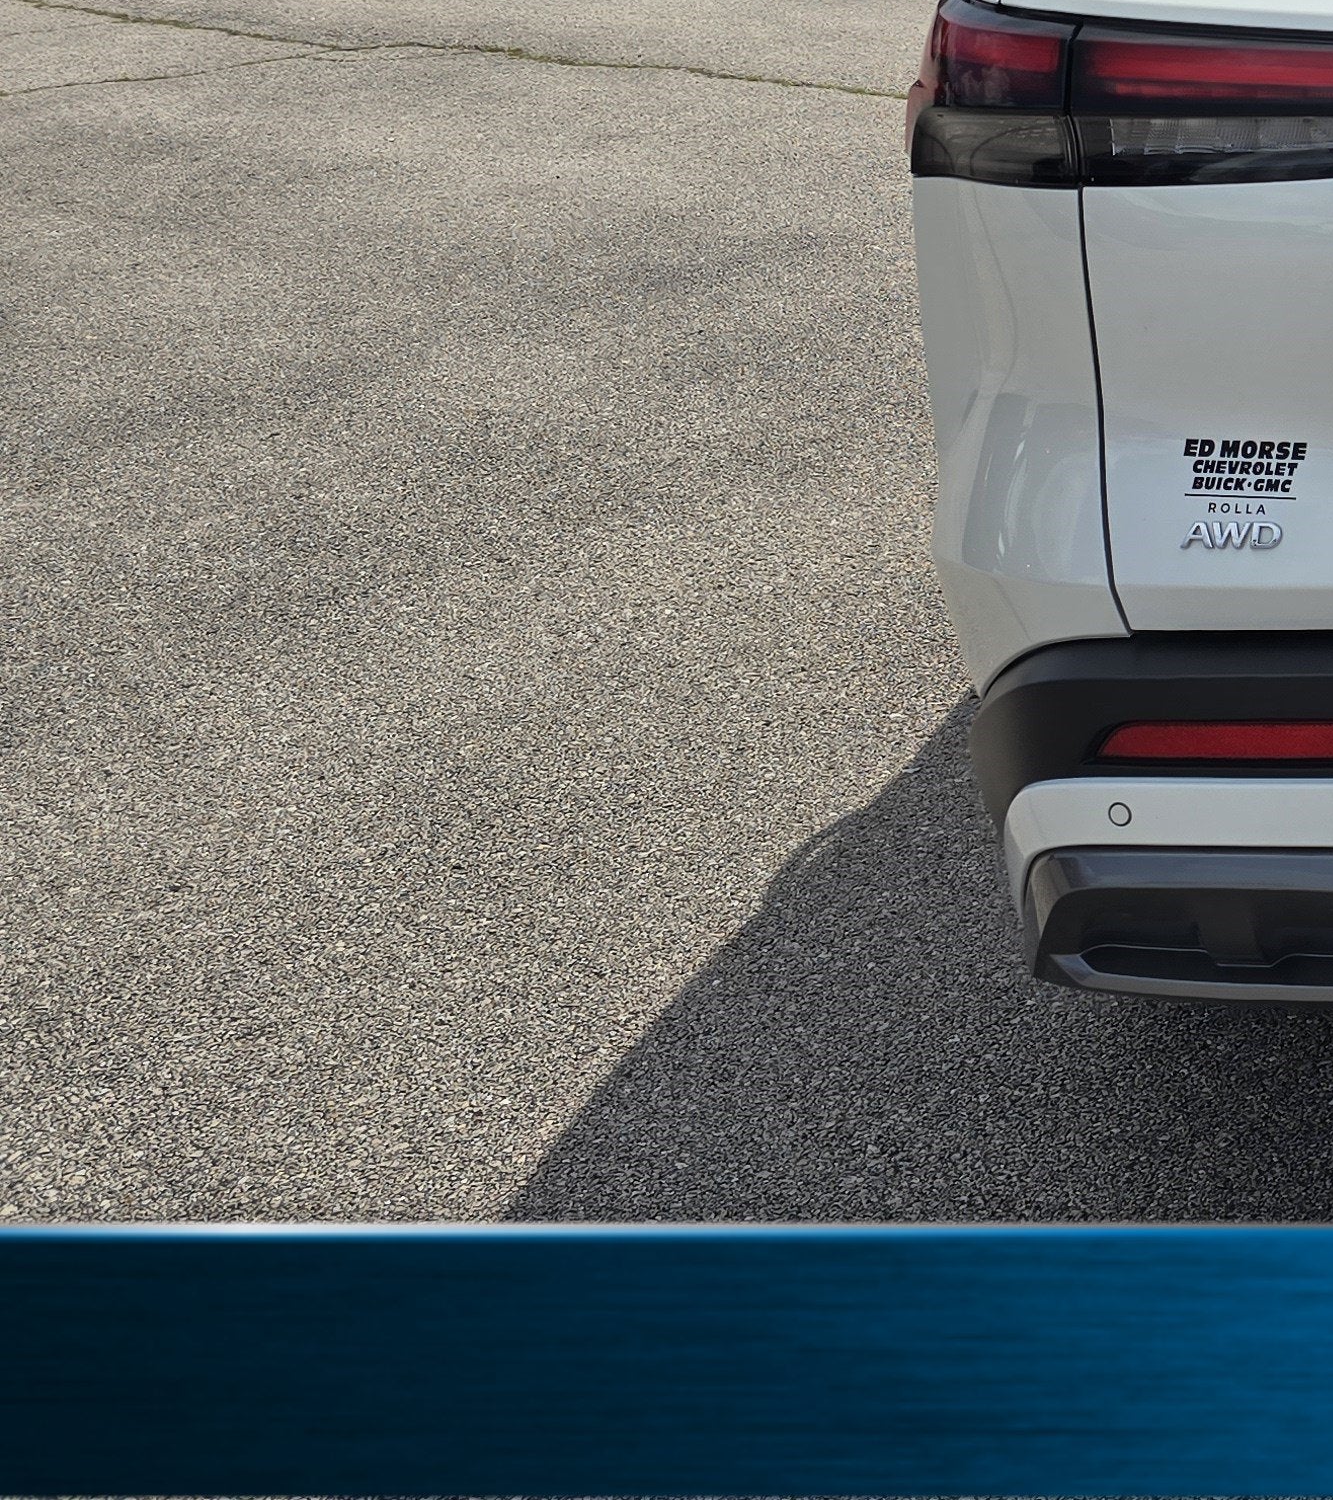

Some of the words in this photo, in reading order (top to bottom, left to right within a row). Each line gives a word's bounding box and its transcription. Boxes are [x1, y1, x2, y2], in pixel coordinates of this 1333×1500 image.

[1183, 438, 1215, 457] ED
[1220, 440, 1308, 461] MORSE
[1192, 460, 1298, 476] CHEVROLET
[1208, 503, 1267, 515] ROLLA
[1180, 521, 1284, 550] AWD
